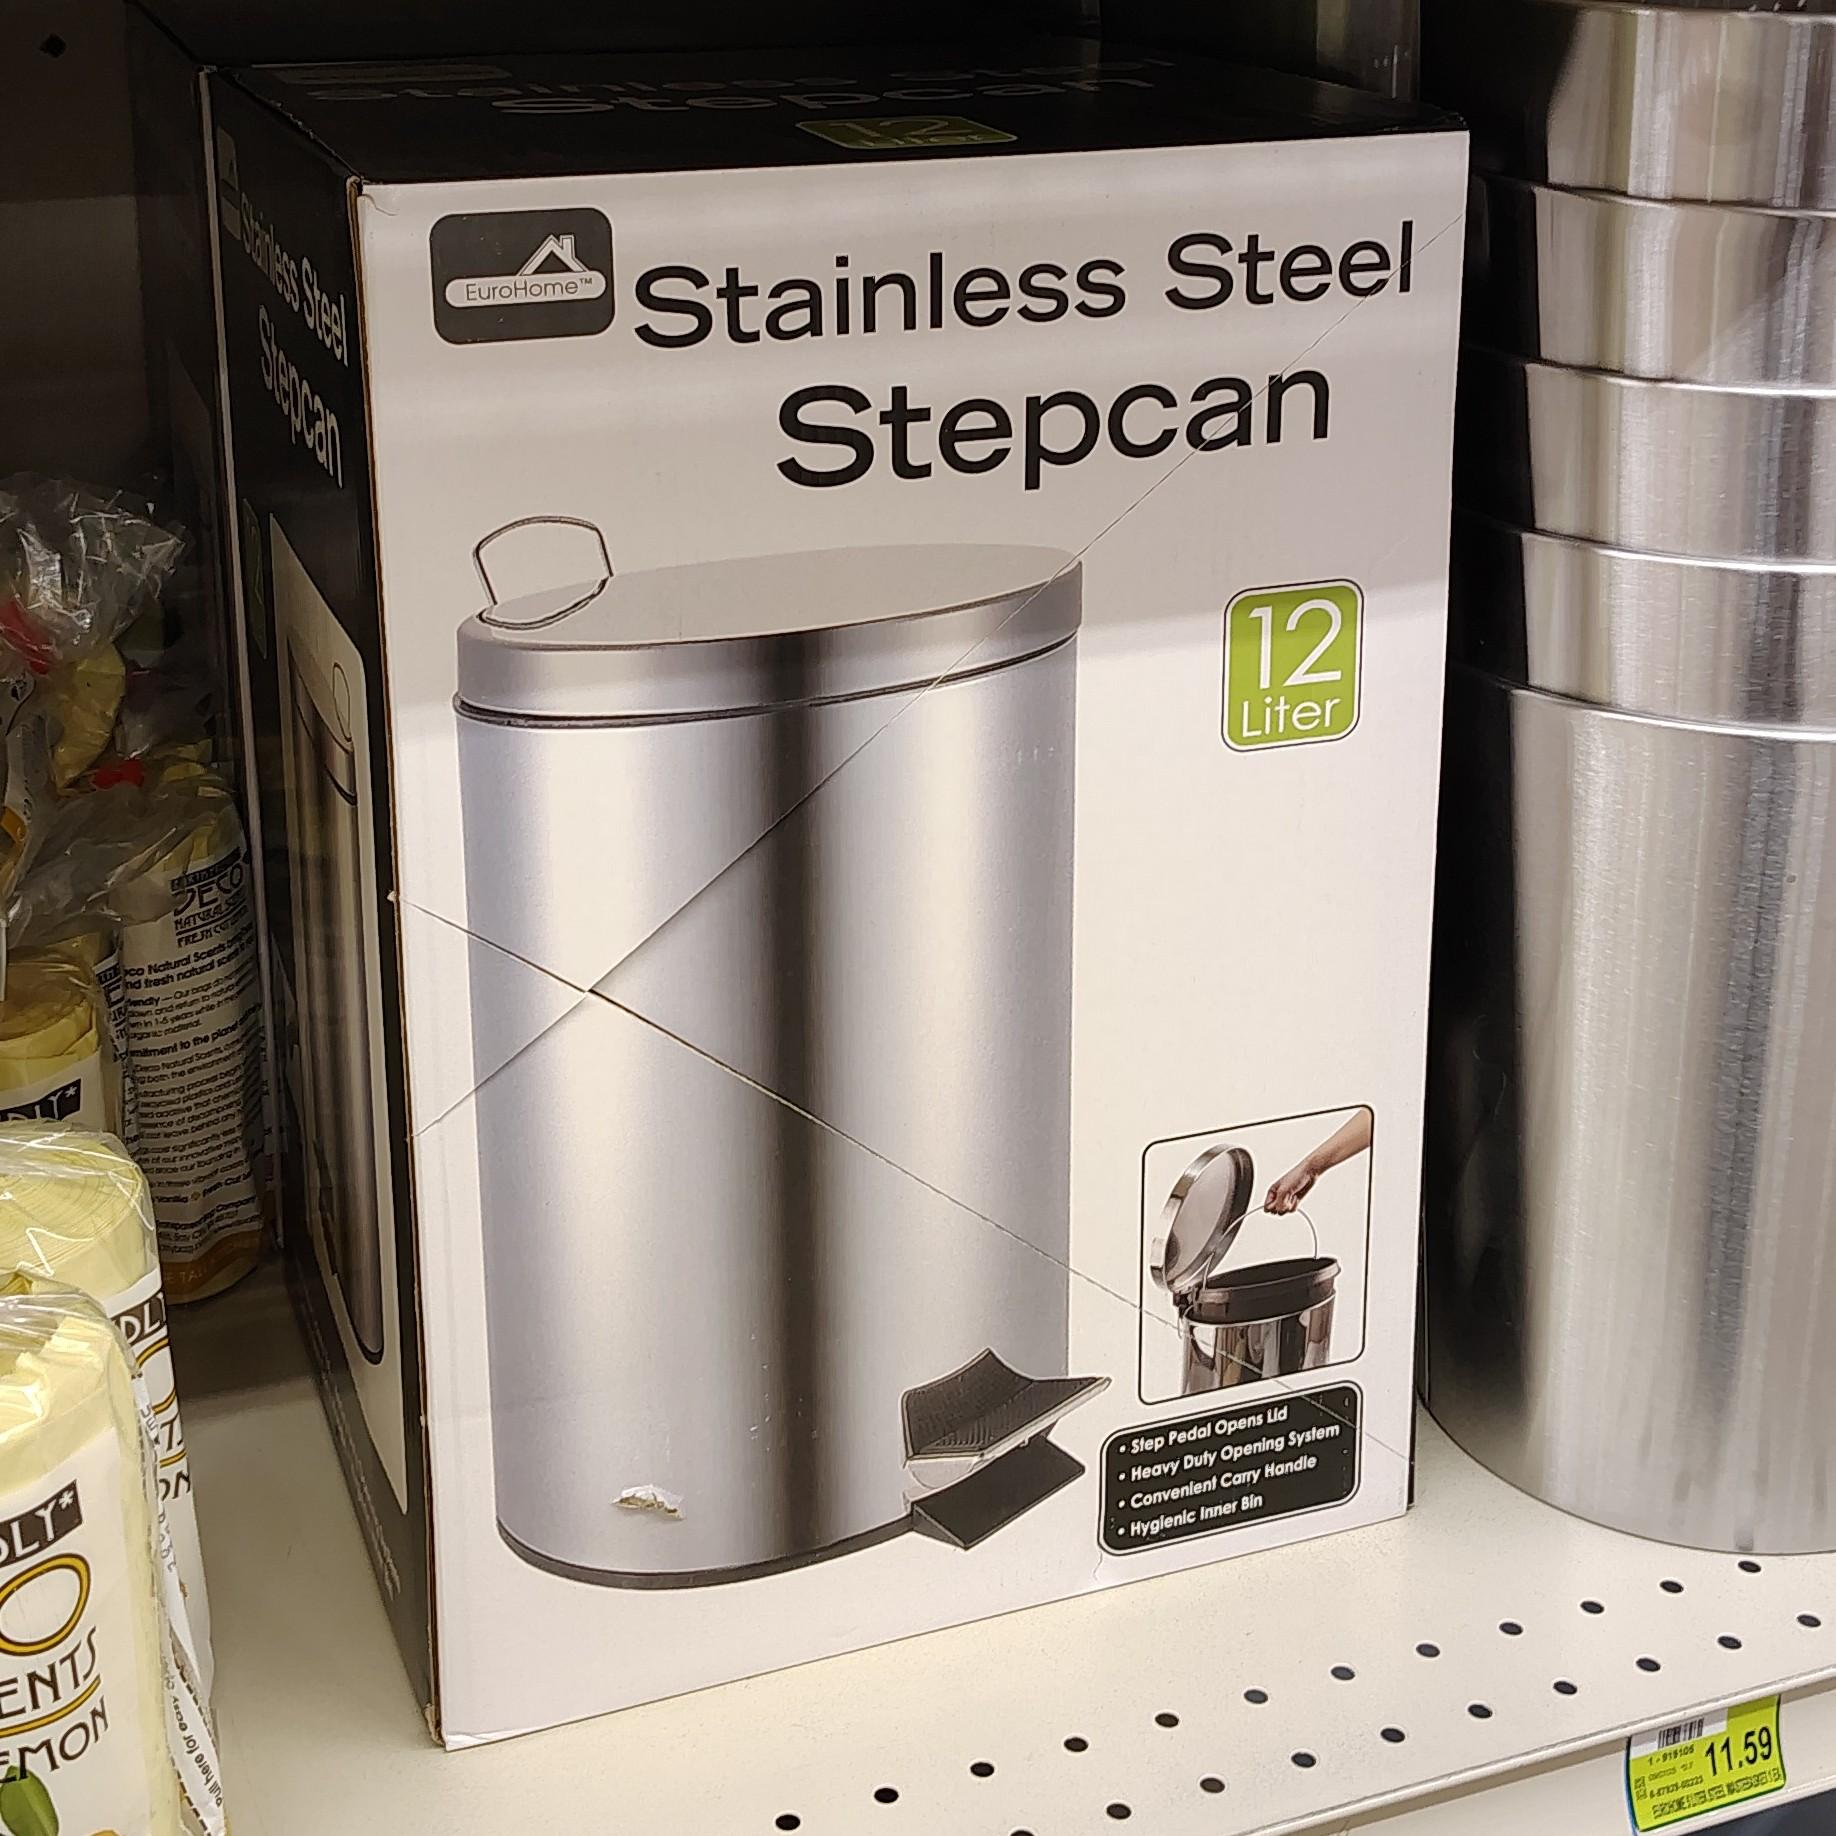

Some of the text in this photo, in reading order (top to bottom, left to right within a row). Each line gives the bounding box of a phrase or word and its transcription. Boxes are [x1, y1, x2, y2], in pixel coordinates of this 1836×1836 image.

[491, 78, 1154, 114] Stepcan
[829, 117, 973, 138] 12
[240, 192, 348, 365] Stainless Steel
[633, 219, 1415, 349] Stainless Steel
[259, 305, 342, 488] Stepcan
[777, 367, 1331, 491] Stepcan
[1248, 598, 1342, 690] 12
[1242, 695, 1342, 738] Liter
[148, 955, 191, 974] Natural
[177, 959, 215, 980] natural
[180, 1040, 191, 1050] to
[192, 1034, 210, 1046] the
[1130, 1404, 1289, 1455] Step Pedal Opens Lid
[1130, 1423, 1341, 1484] Heavy Duty Opening System
[1130, 1455, 1318, 1510] Convenient Carry Handle
[1130, 1493, 1264, 1538] Hygienic Inner Bin
[171, 1695, 224, 1809] pull here for easy
[1705, 1726, 1773, 1777] 11.59
